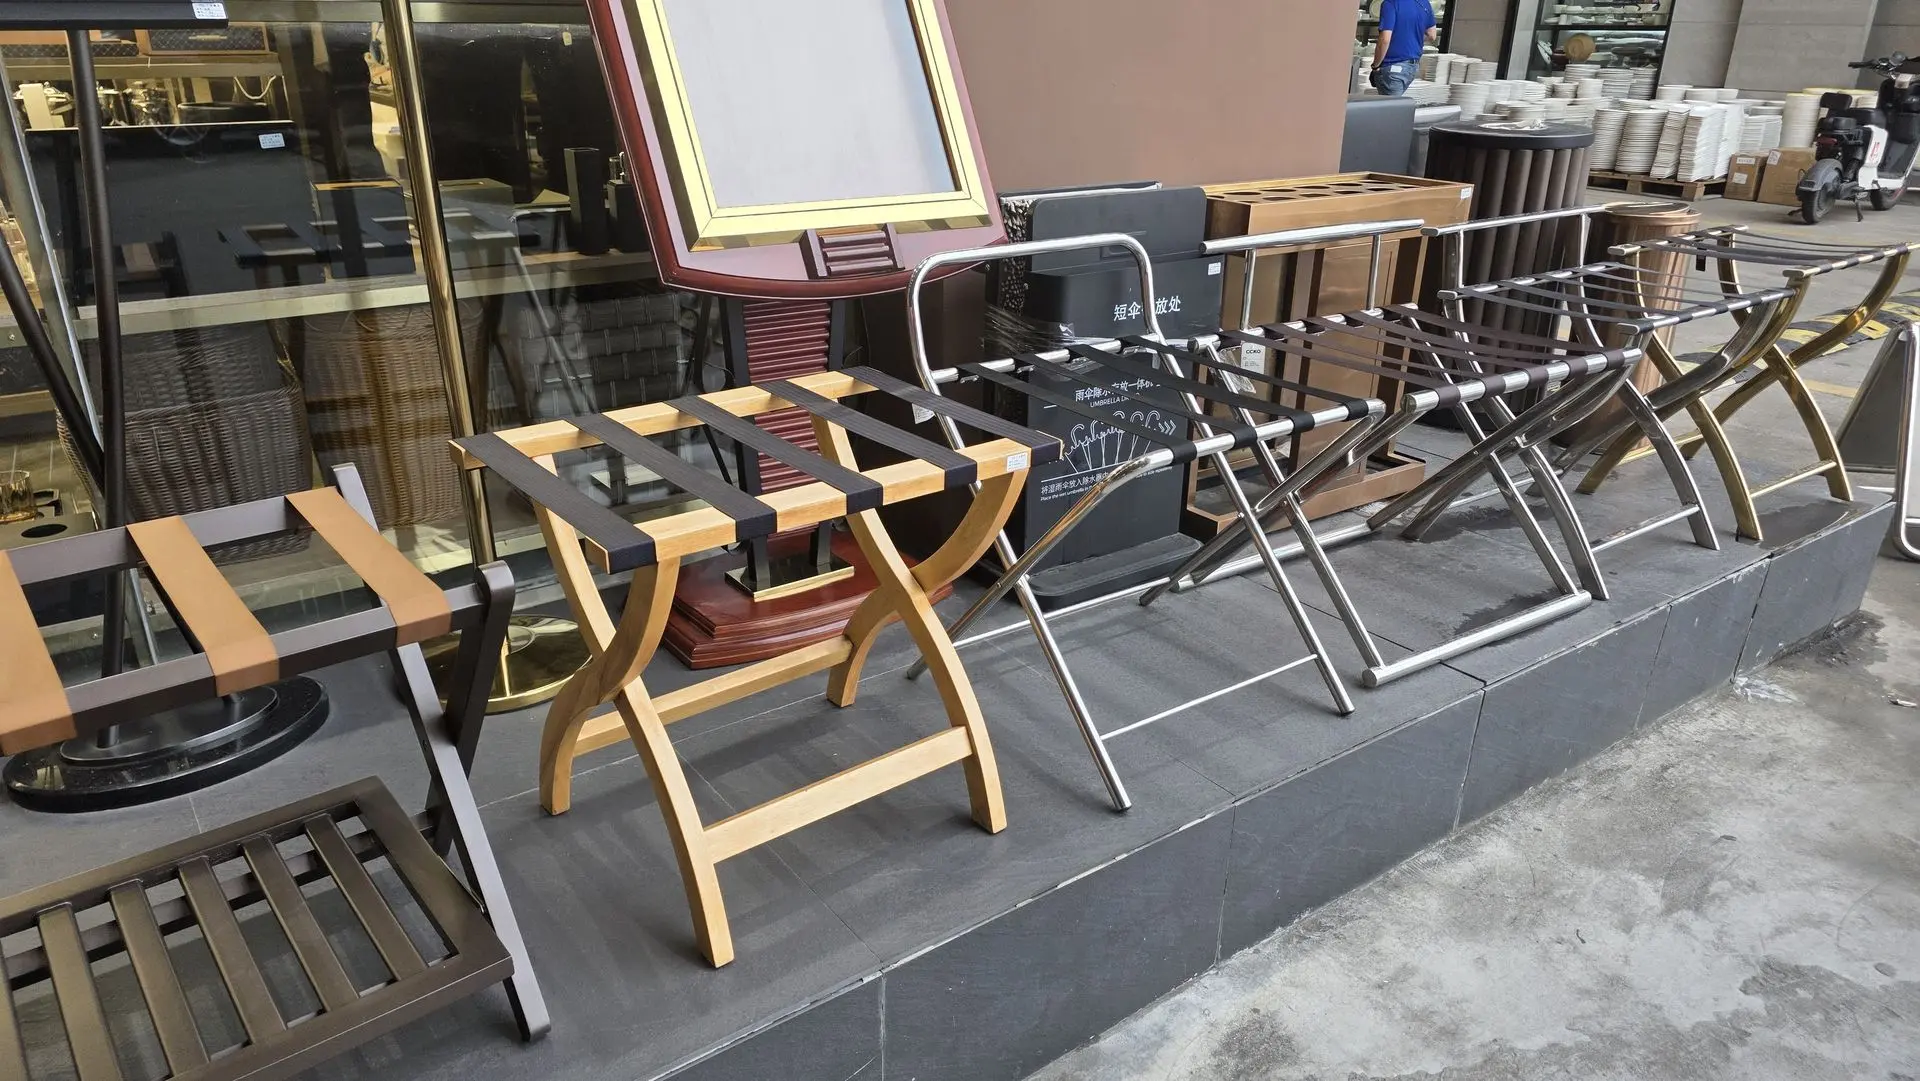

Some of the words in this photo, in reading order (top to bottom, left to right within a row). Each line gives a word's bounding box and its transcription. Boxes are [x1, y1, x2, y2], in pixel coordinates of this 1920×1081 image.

[1113, 295, 1182, 321] 短伞放处
[1090, 395, 1120, 408] UMBRELLA
